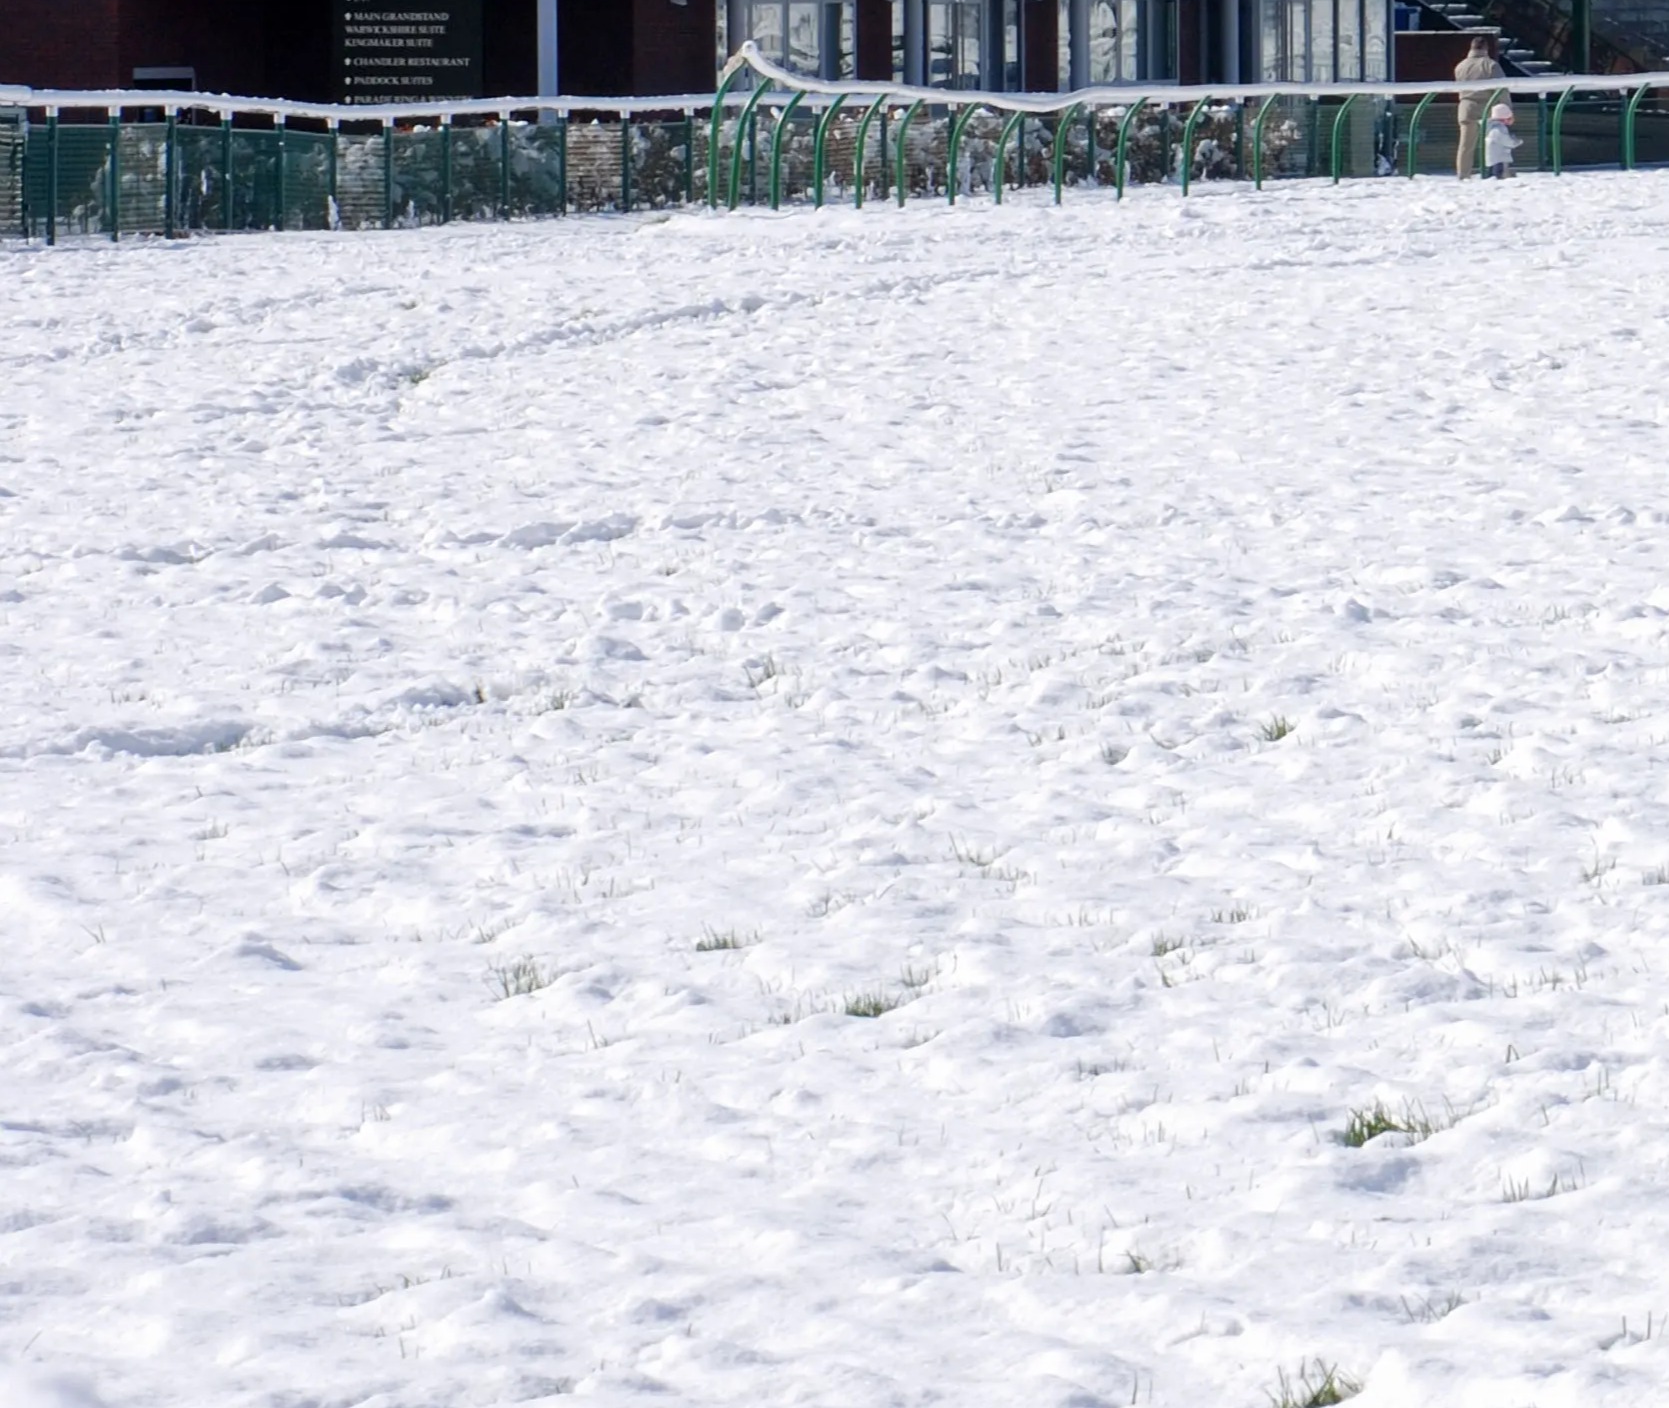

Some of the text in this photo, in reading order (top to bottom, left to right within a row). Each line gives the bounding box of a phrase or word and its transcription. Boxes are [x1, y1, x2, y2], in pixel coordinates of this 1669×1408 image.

[353, 12, 450, 21] MAIN GRANDSTAND
[345, 25, 446, 34] WARWICKSHIRE SUITE
[344, 38, 433, 47] KINGMAKER SUITE
[353, 57, 471, 67] CHANDLER RESTAURANT
[353, 76, 434, 85] PADDOCK SUITES
[353, 95, 392, 104] PARADE
